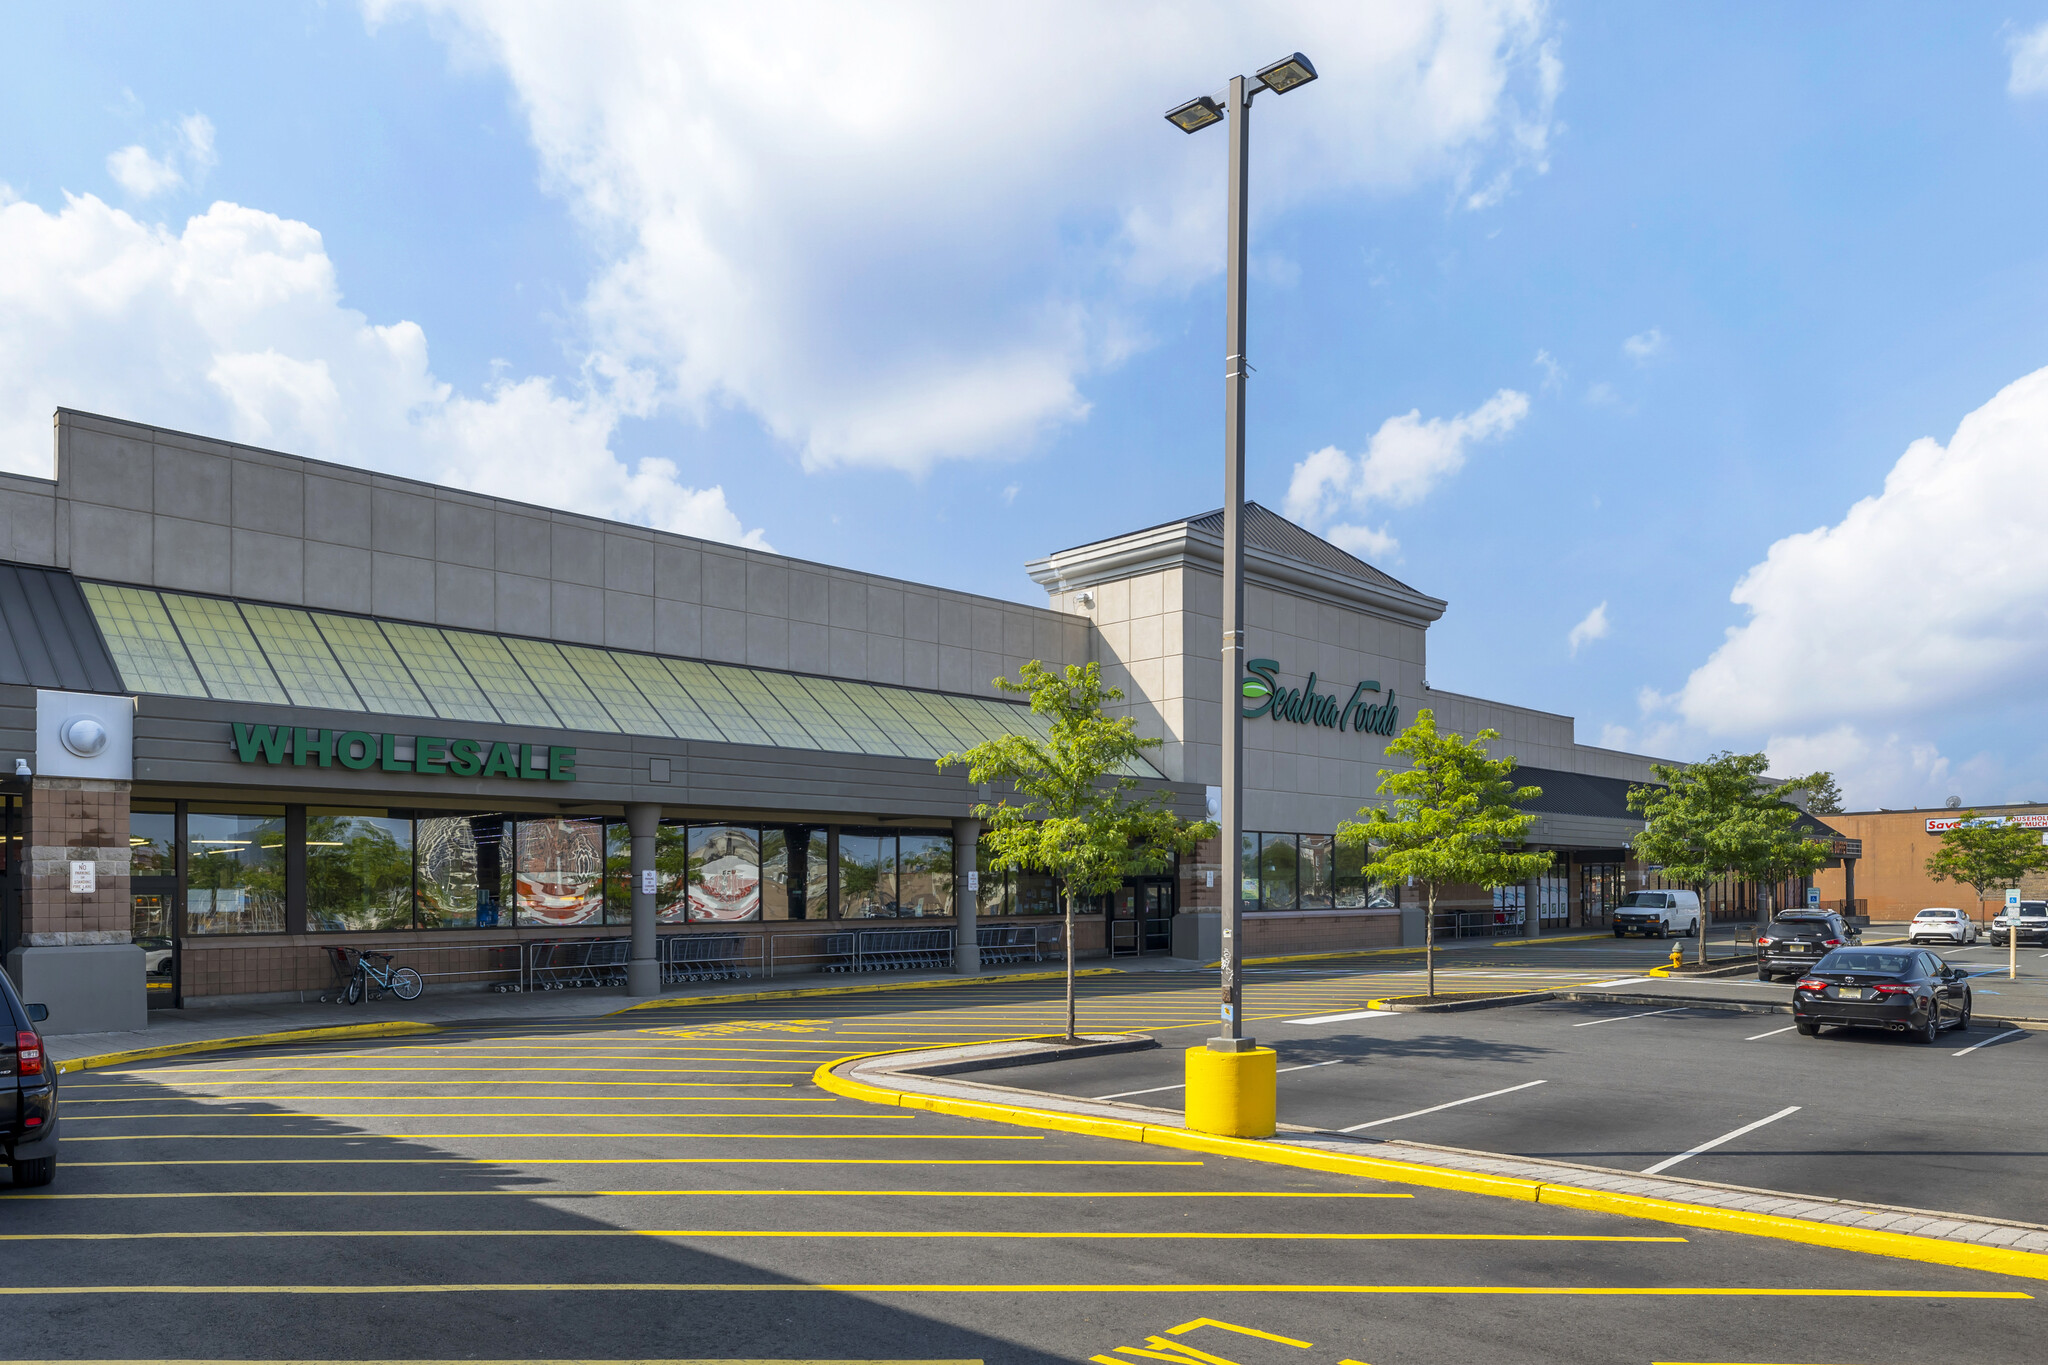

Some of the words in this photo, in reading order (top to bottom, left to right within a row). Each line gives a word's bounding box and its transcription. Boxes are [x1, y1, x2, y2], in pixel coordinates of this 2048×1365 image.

[1243, 658, 1340, 729] Seabra
[1340, 680, 1399, 737] Foods
[231, 722, 577, 781] WHOLESALE
